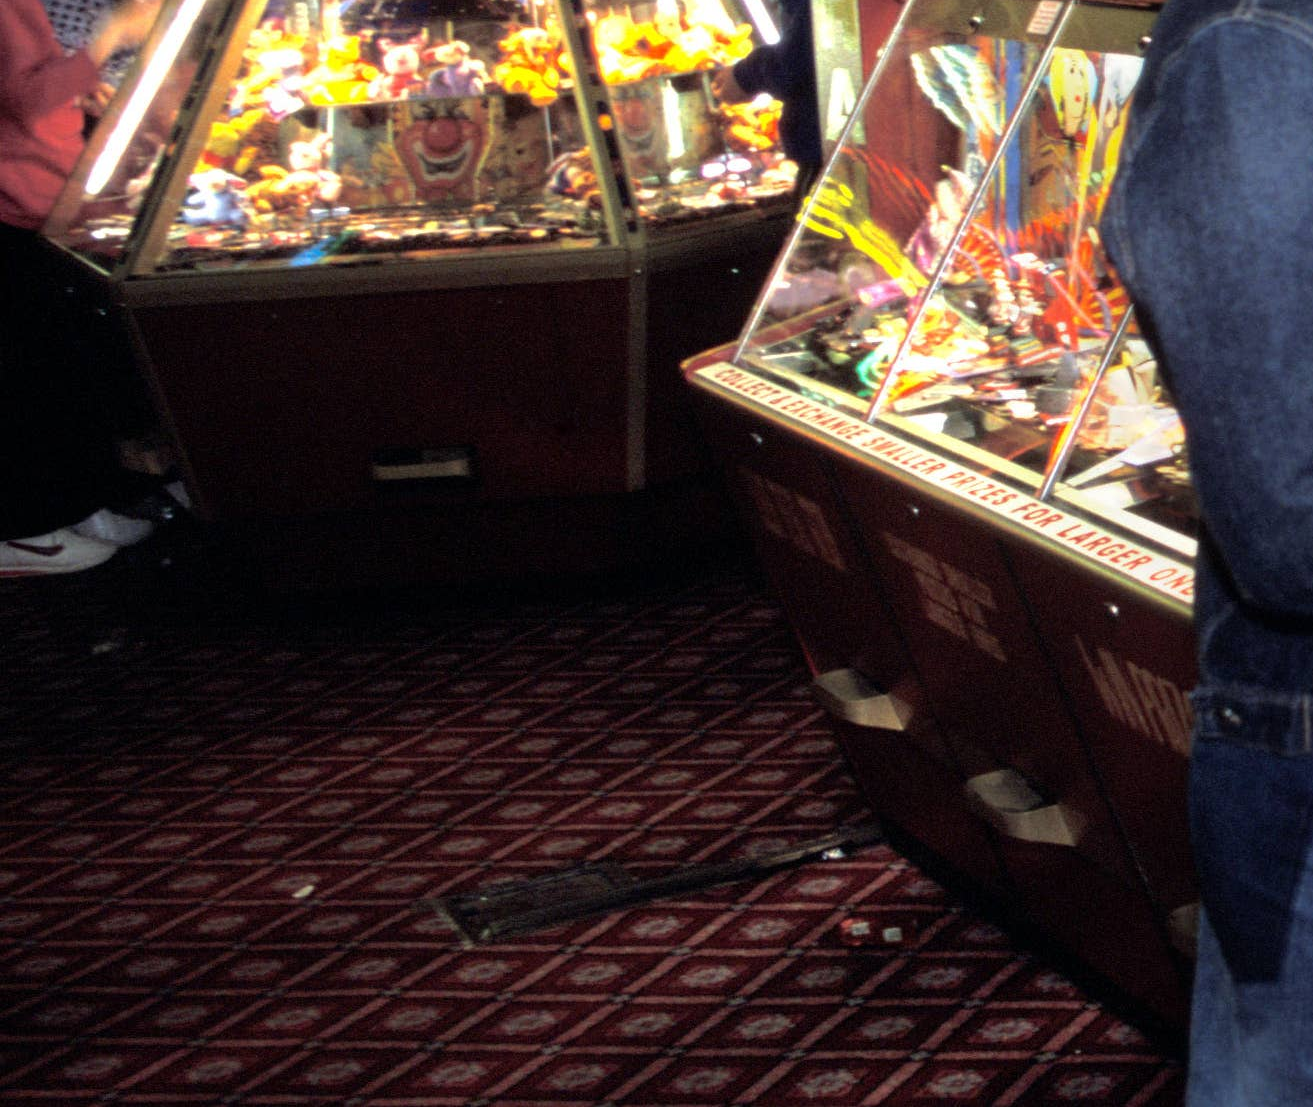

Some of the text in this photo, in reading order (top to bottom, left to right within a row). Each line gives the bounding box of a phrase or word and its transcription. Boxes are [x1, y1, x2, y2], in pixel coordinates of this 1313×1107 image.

[714, 367, 782, 402] COLLECT
[780, 398, 867, 441] EXCHANGE
[861, 436, 947, 476] SMALLER
[941, 470, 1018, 506] PRIZES
[1011, 502, 1064, 529] FOR
[1056, 523, 1153, 571] LARGER
